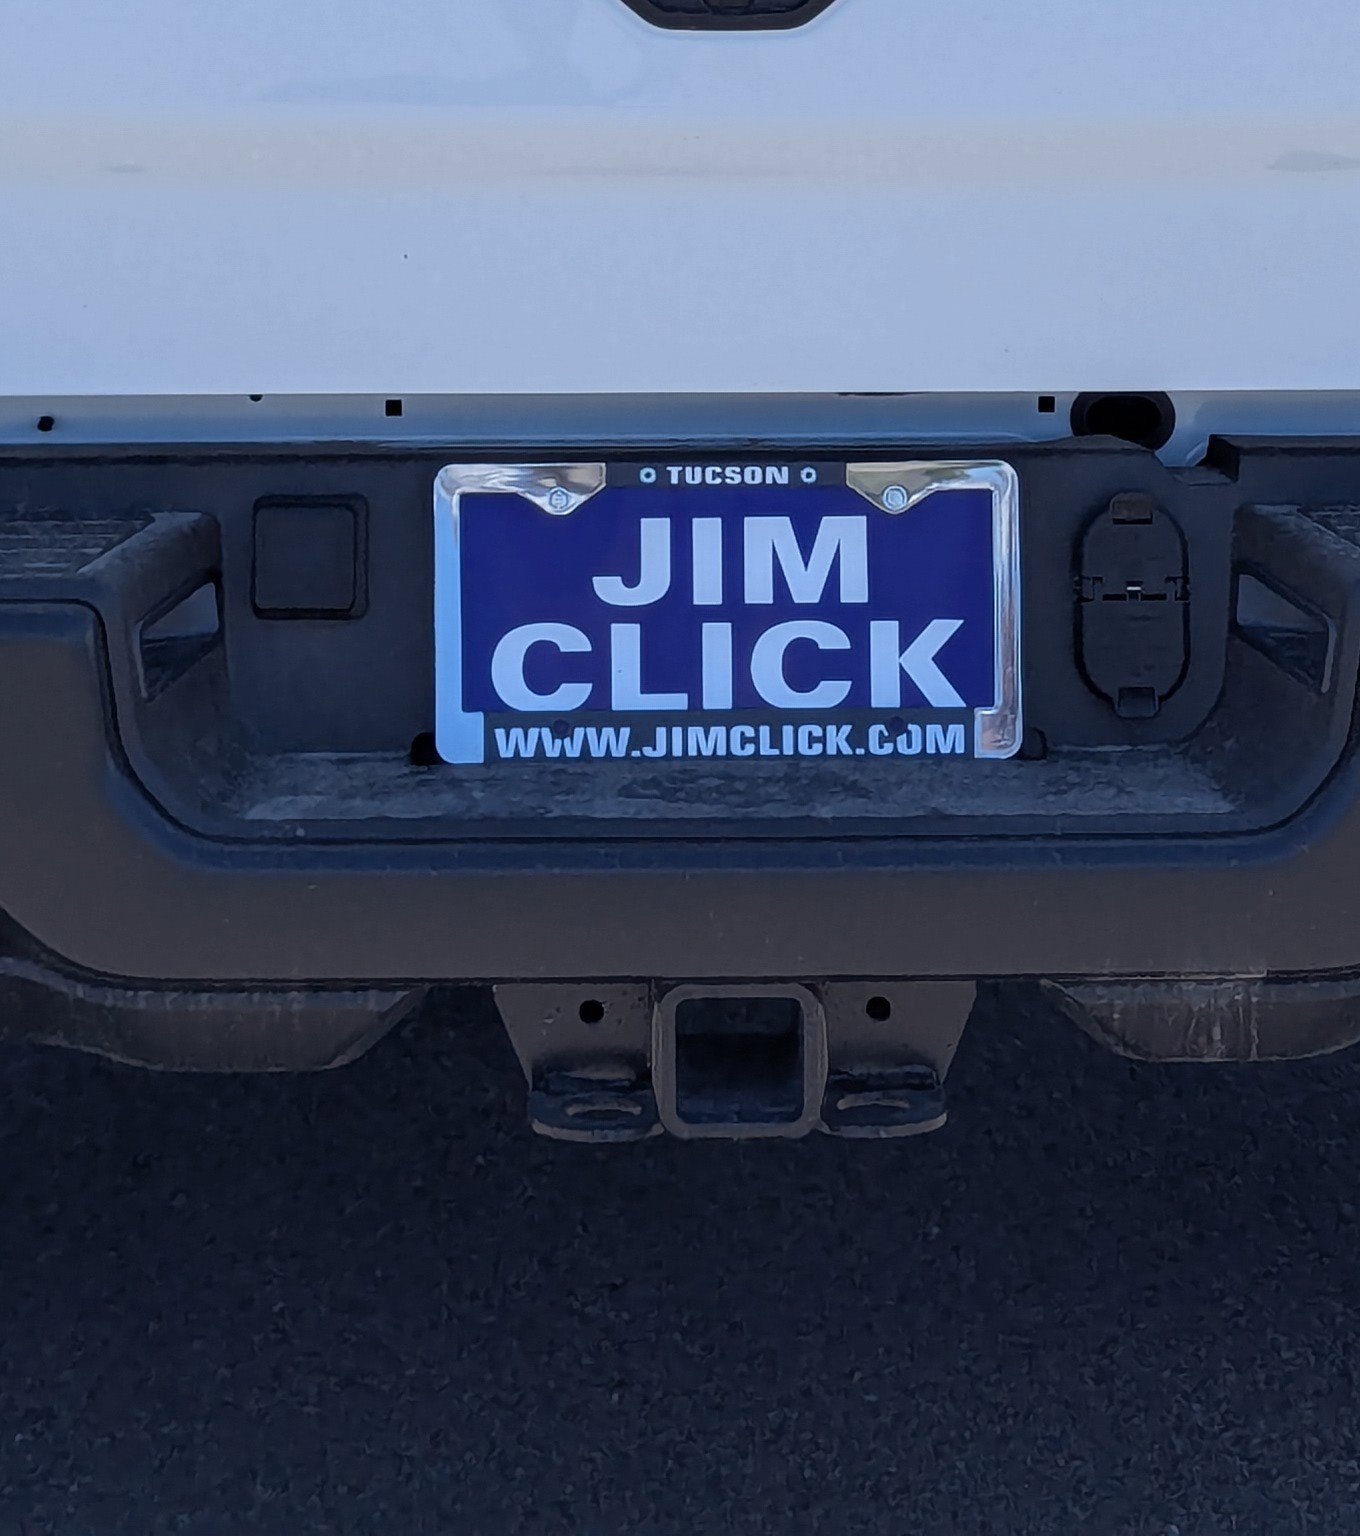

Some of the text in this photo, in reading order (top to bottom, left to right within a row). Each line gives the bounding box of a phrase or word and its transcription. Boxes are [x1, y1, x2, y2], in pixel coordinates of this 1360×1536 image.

[666, 466, 789, 485] TUCSON
[592, 515, 869, 606] JIM
[491, 619, 967, 712] CLICK
[494, 723, 965, 758] WWW.JIMCLICK.COM
